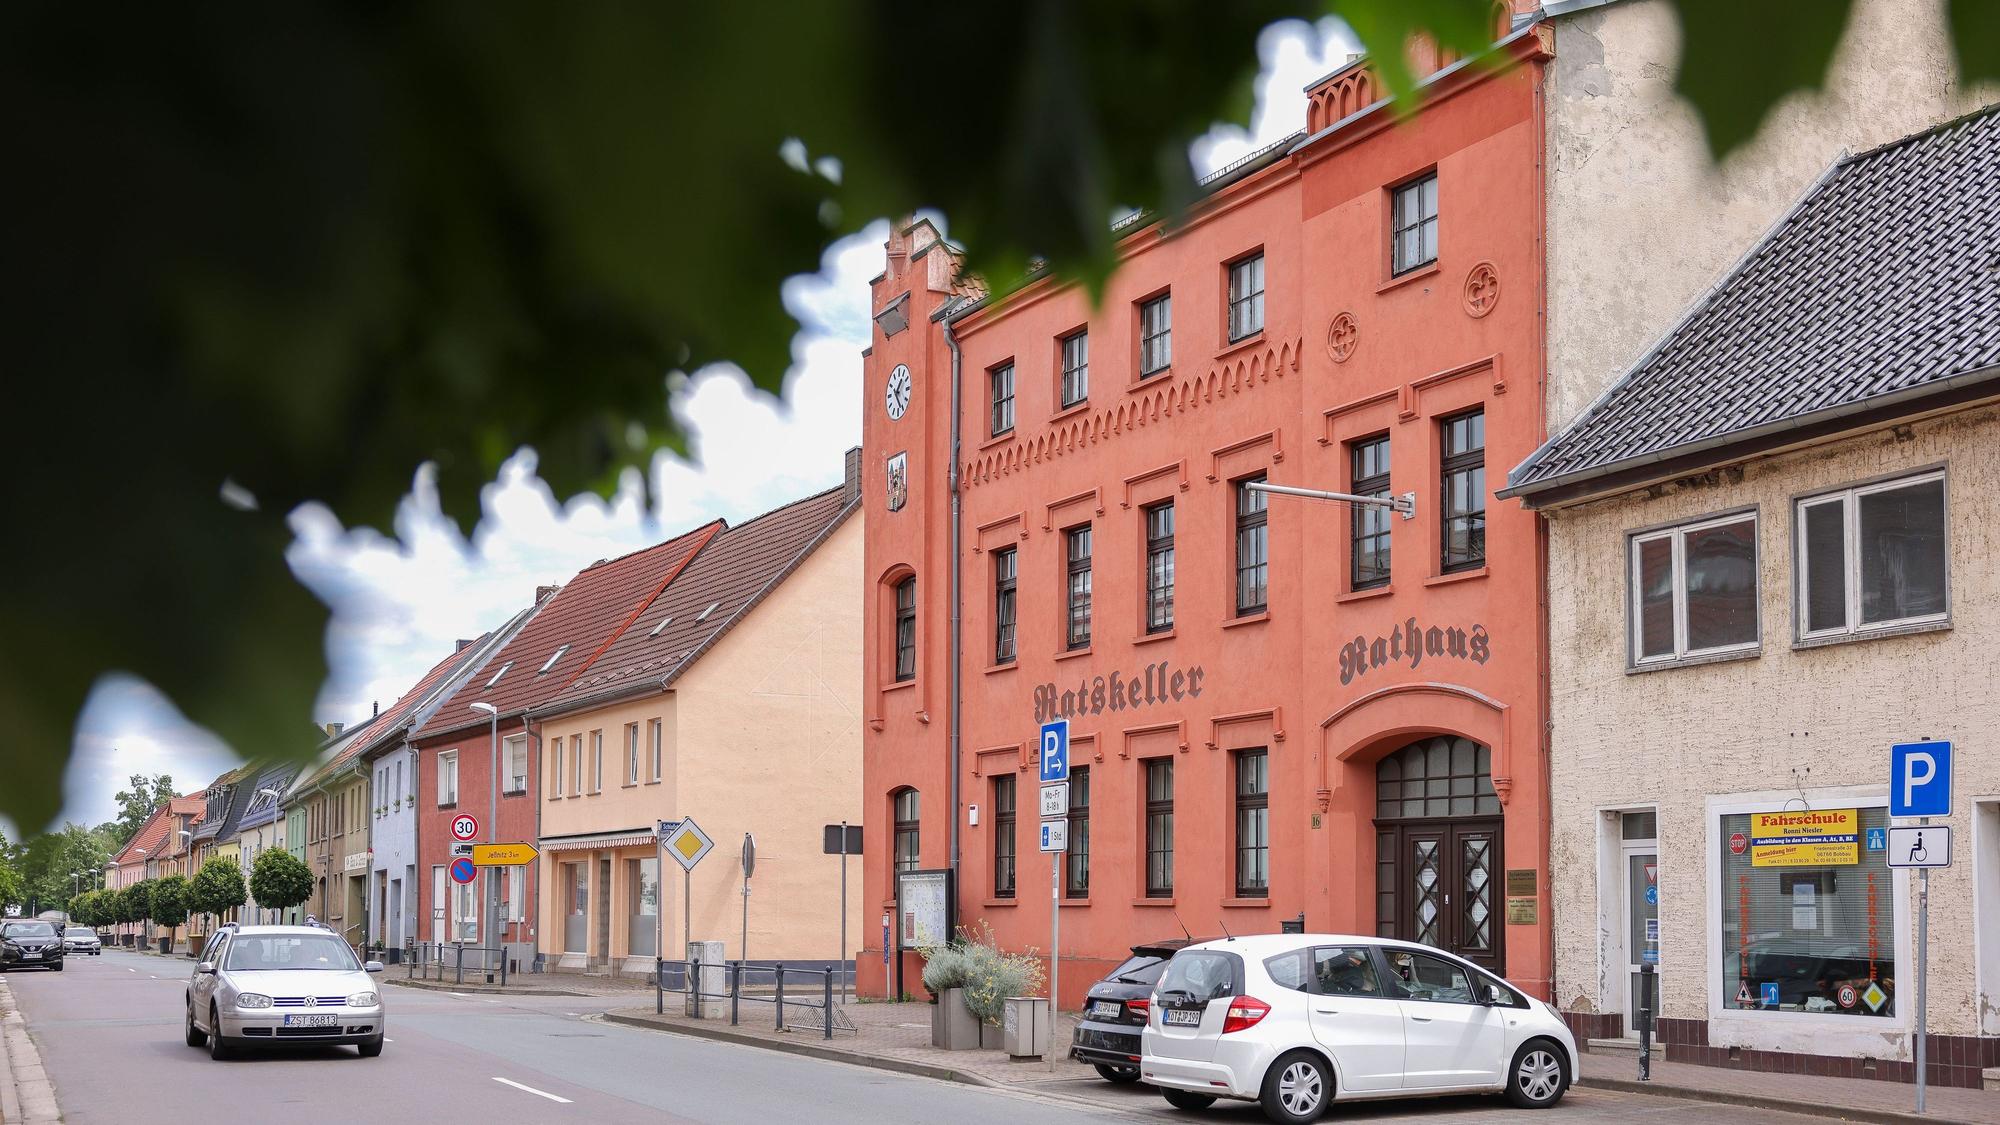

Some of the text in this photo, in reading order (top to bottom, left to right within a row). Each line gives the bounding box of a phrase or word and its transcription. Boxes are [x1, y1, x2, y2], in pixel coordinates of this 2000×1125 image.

[1339, 616, 1490, 686] Rathaus
[1034, 660, 1205, 725] Ratskeller
[1044, 730, 1059, 774] P
[1903, 752, 1937, 807] P
[1045, 790, 1060, 799] Mo-Fr
[1312, 816, 1320, 826] 16
[1760, 812, 1847, 827] Fahrschule
[456, 821, 473, 834] 30
[1730, 839, 1745, 848] STOP
[1756, 837, 1785, 845] Ausbildung
[487, 851, 507, 859] Jeßnitz
[1755, 848, 1785, 858] Anmeldung
[1842, 991, 1853, 1002] 60
[290, 1015, 336, 1025] ZST 86813
